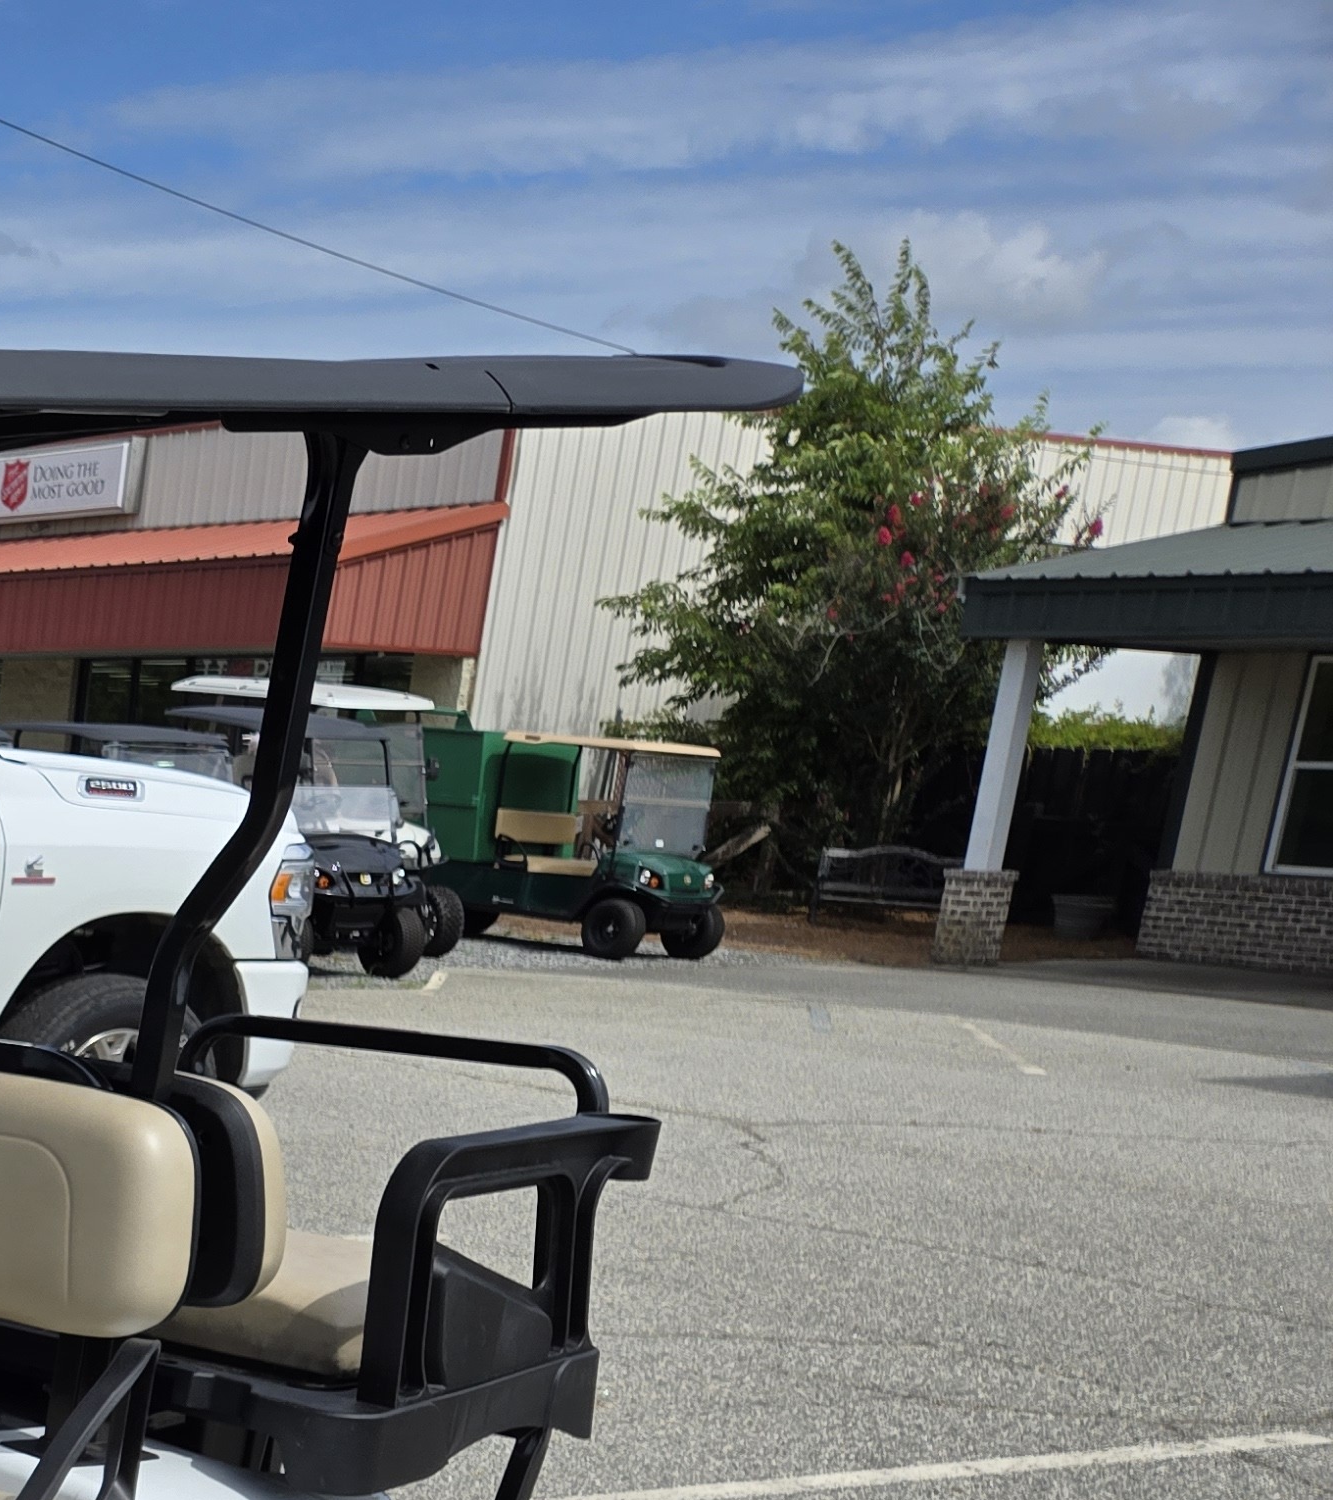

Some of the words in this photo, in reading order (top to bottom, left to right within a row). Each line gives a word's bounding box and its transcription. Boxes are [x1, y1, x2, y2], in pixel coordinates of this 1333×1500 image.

[33, 464, 75, 483] DOING
[77, 461, 100, 478] THE
[30, 483, 64, 499] MOST
[66, 479, 105, 498] GOOD
